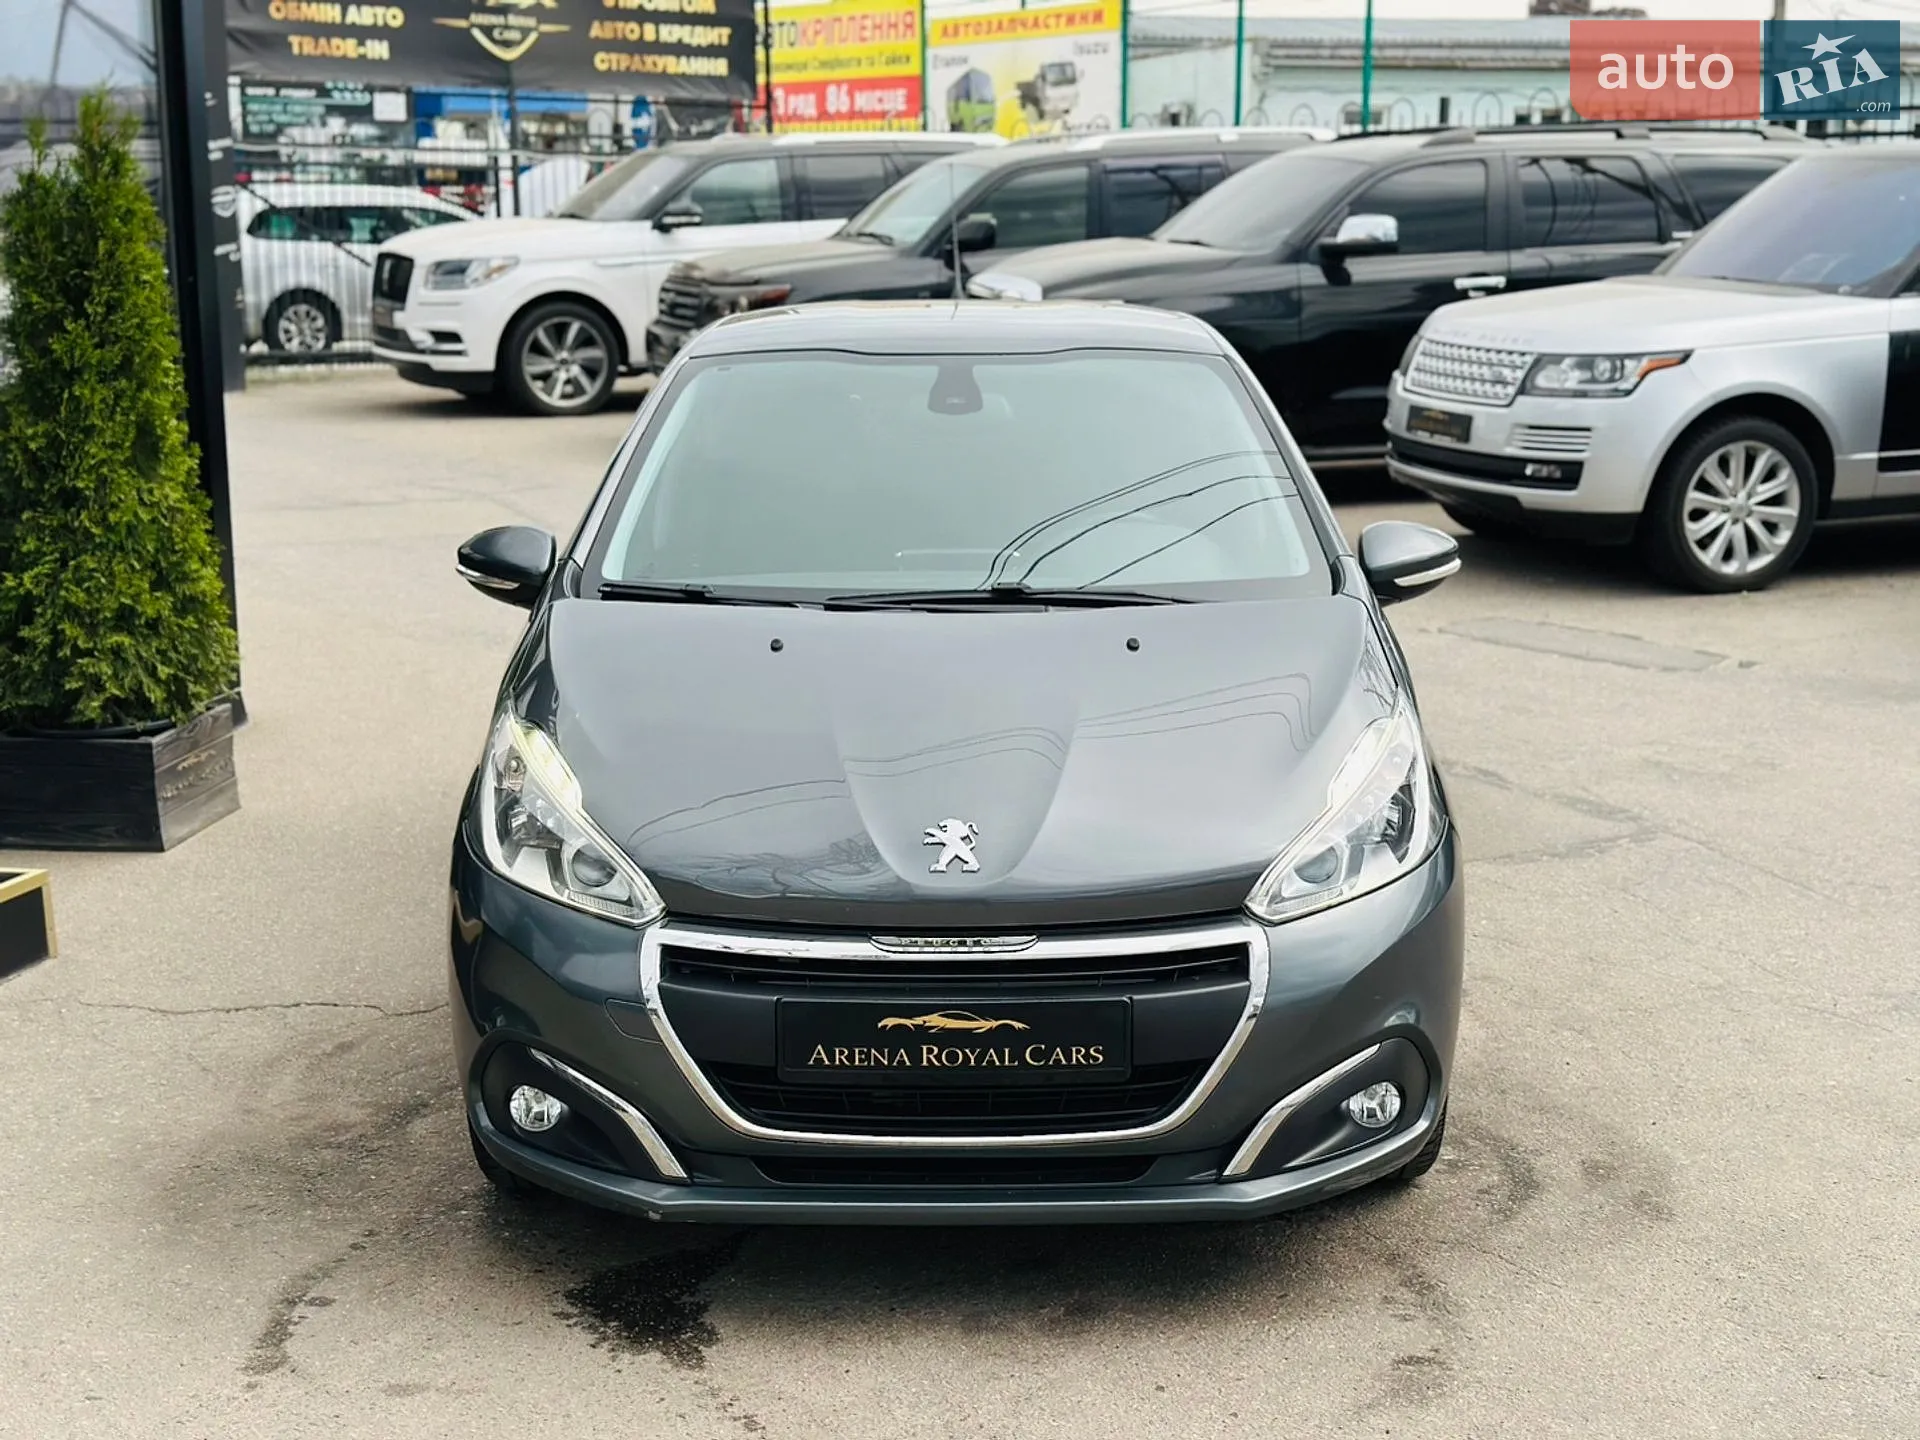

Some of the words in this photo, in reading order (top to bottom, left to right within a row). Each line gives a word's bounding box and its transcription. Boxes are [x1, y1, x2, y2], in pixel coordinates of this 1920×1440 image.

[269, 1, 342, 24] ОБМІН
[345, 4, 405, 28] АВТО
[940, 9, 1106, 40] АВТОЗАПЧАСТИНИ
[589, 20, 641, 41] АВТО
[643, 22, 657, 42] В
[659, 24, 731, 47] КРЕДИТ
[287, 34, 391, 60] TRADE-IN
[593, 51, 729, 77] СТРАХУВАННЯ
[807, 1044, 912, 1067] ARENA
[919, 1044, 1019, 1067] ROYAL
[1025, 1043, 1104, 1066] CARS
